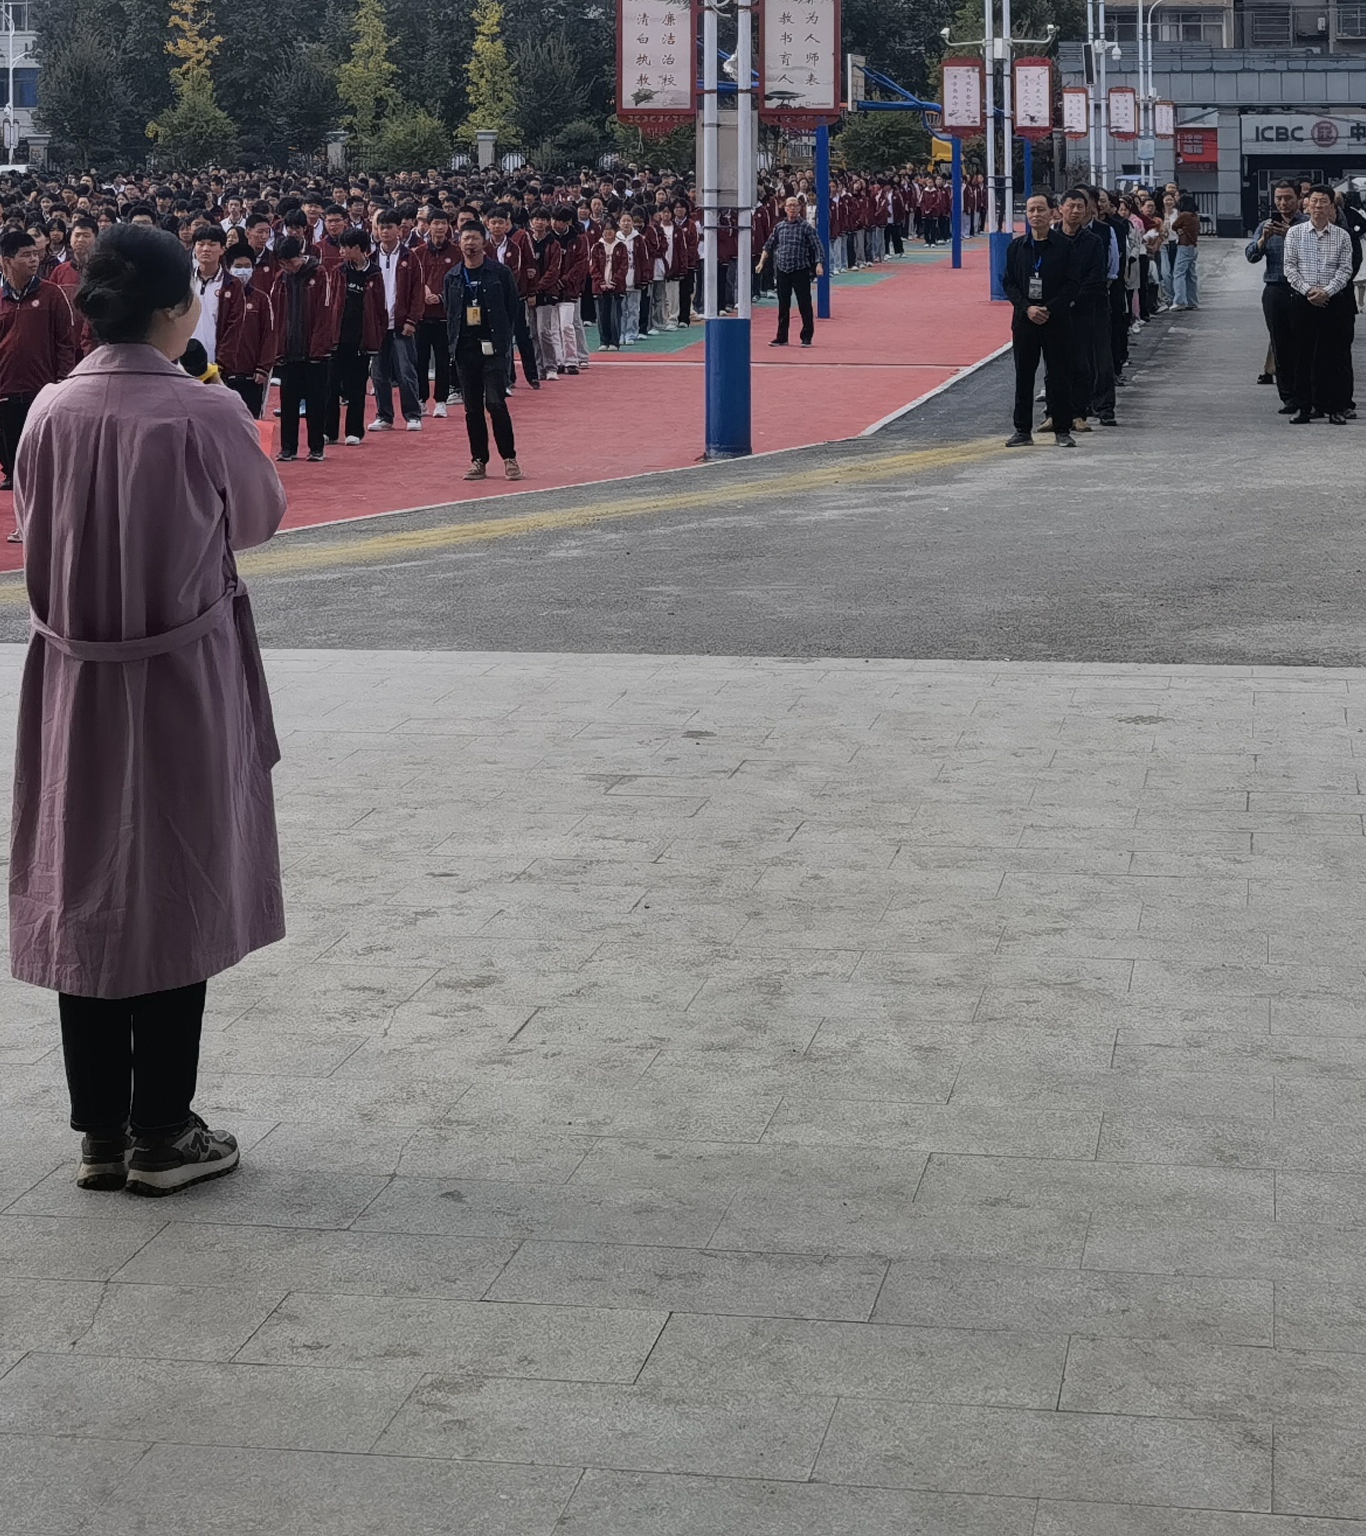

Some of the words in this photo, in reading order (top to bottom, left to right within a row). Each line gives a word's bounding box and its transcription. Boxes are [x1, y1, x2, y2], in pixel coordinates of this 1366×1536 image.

[635, 12, 652, 86] 清白执教
[660, 11, 677, 86] 廉洁治校
[777, 11, 795, 84] 教书育人
[804, 11, 821, 86] 为人师表
[1255, 125, 1305, 143] ICBC
